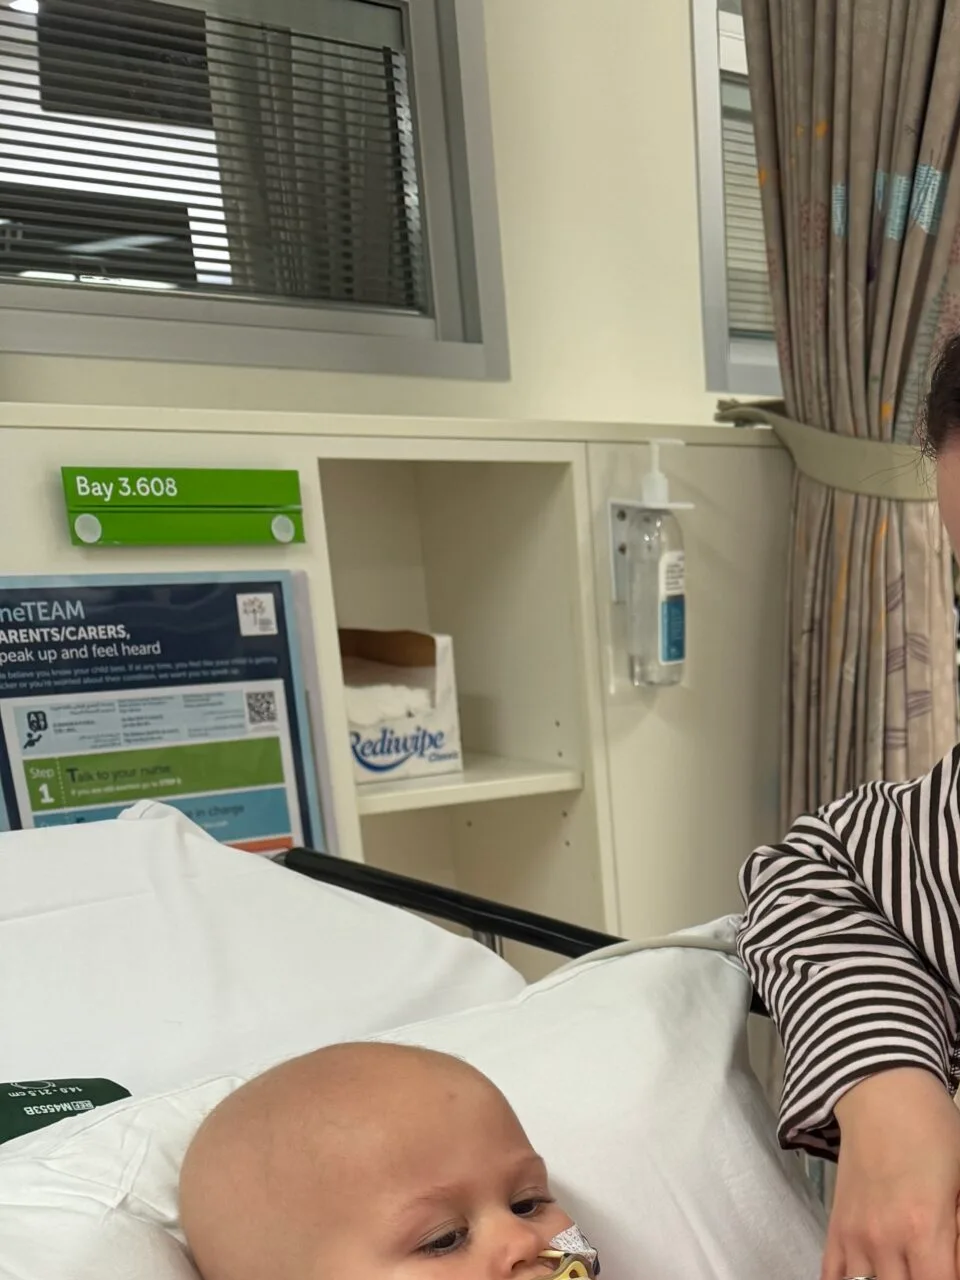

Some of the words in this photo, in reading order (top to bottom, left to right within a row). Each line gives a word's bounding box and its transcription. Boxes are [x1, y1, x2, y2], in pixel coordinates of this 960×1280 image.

[75, 475, 114, 502] Bay
[118, 476, 178, 497] 3.608
[0, 600, 86, 623] neTEAM
[0, 624, 131, 645] ARENTS/CARERS,
[0, 647, 35, 667] peak
[38, 650, 58, 663] up
[61, 644, 89, 660] and
[92, 643, 119, 658] feel
[121, 640, 162, 656] heard
[349, 725, 446, 762] Rediwipe
[30, 766, 56, 780] Step
[96, 770, 110, 781] to
[111, 768, 136, 783] your
[38, 783, 55, 804] 1
[24, 1102, 73, 1116] M4553B
